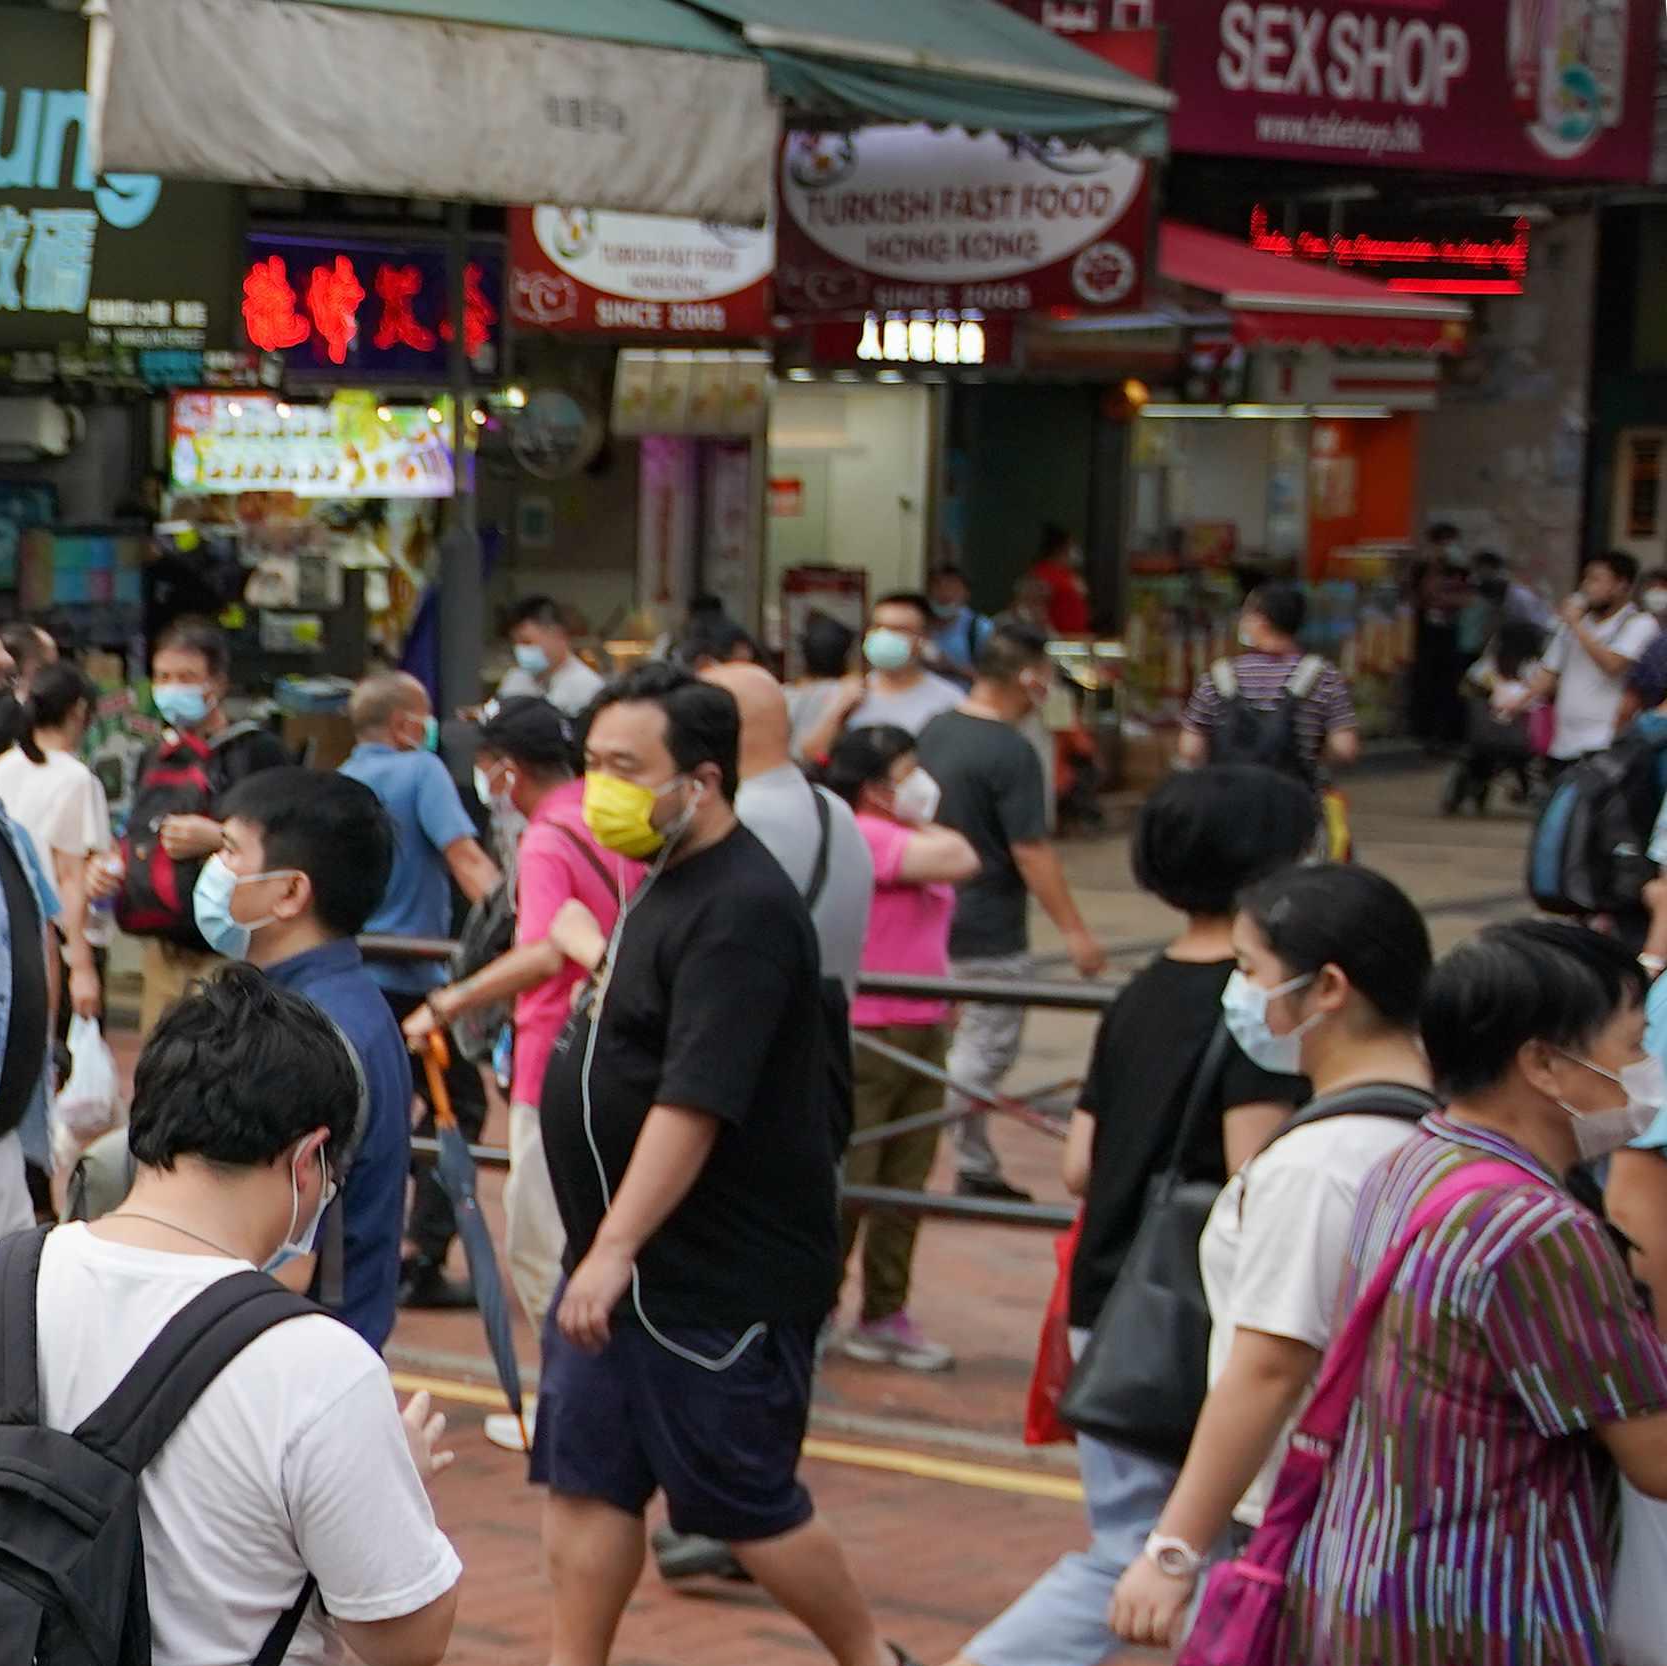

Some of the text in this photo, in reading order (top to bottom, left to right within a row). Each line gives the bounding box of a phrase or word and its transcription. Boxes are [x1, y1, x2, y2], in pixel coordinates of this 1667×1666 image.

[1217, 2, 1470, 107] SEX SHOP
[806, 181, 1113, 227] TURKISH FAST FOOD
[870, 228, 1042, 263] HONG KONG
[595, 299, 663, 329] SINCE
[874, 285, 949, 310] SINCE
